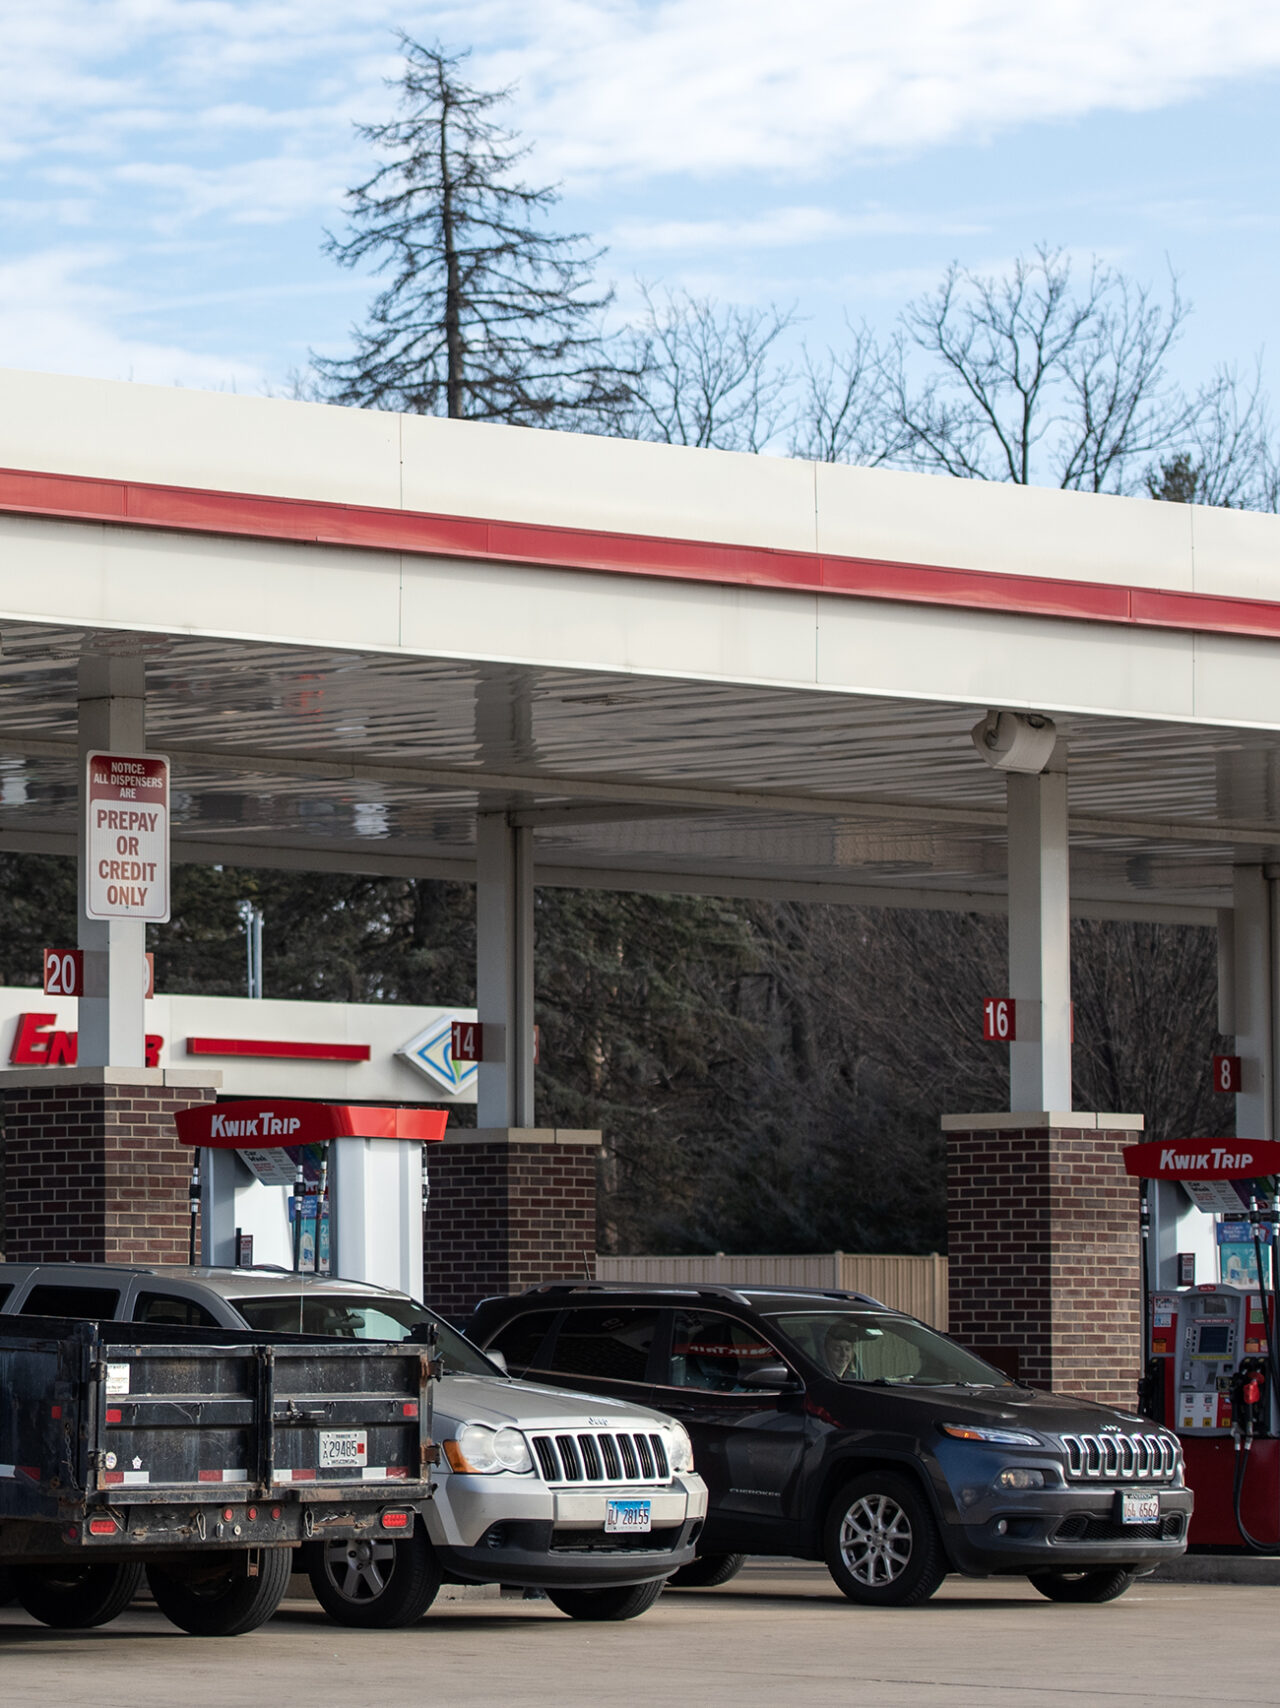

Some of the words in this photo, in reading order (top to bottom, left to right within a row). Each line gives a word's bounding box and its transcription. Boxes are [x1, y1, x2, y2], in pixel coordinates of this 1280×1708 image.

[111, 762, 145, 775] NOTICE:
[93, 773, 109, 785] ALL
[110, 774, 163, 789] DISPENSERS
[119, 787, 137, 799] ARE
[97, 809, 158, 832] PREPAY
[116, 835, 139, 856] OR
[98, 859, 157, 882] CREDIT
[106, 885, 148, 906] ONLY
[46, 953, 76, 994] 20
[985, 1001, 1009, 1038] 16
[452, 1025, 475, 1059] 14
[1220, 1059, 1232, 1090] 8
[329, 1440, 358, 1458] 29485
[623, 1508, 649, 1525] 28155
